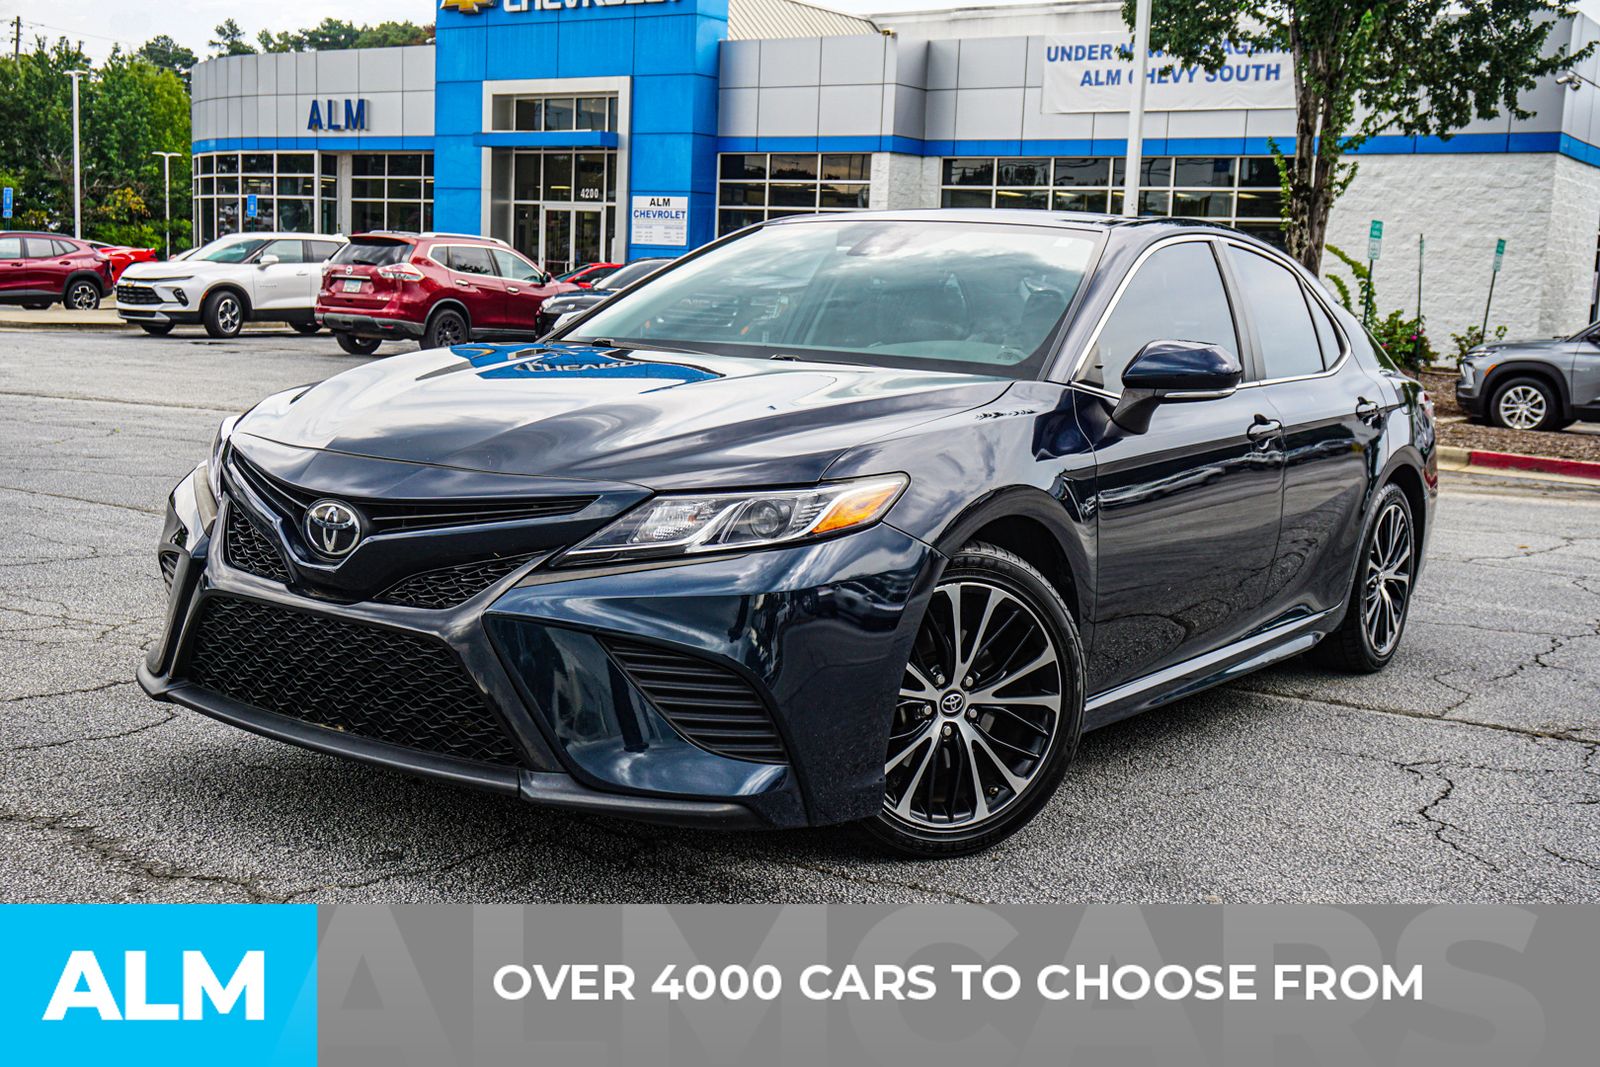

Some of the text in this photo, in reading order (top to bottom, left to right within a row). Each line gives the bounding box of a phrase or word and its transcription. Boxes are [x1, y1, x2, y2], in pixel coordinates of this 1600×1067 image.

[1047, 44, 1114, 62] UNDER
[1080, 69, 1122, 86] ALM
[307, 98, 367, 130] ALM
[580, 188, 599, 199] 4200
[649, 198, 671, 207] ALM
[633, 209, 687, 219] CHEVROLET
